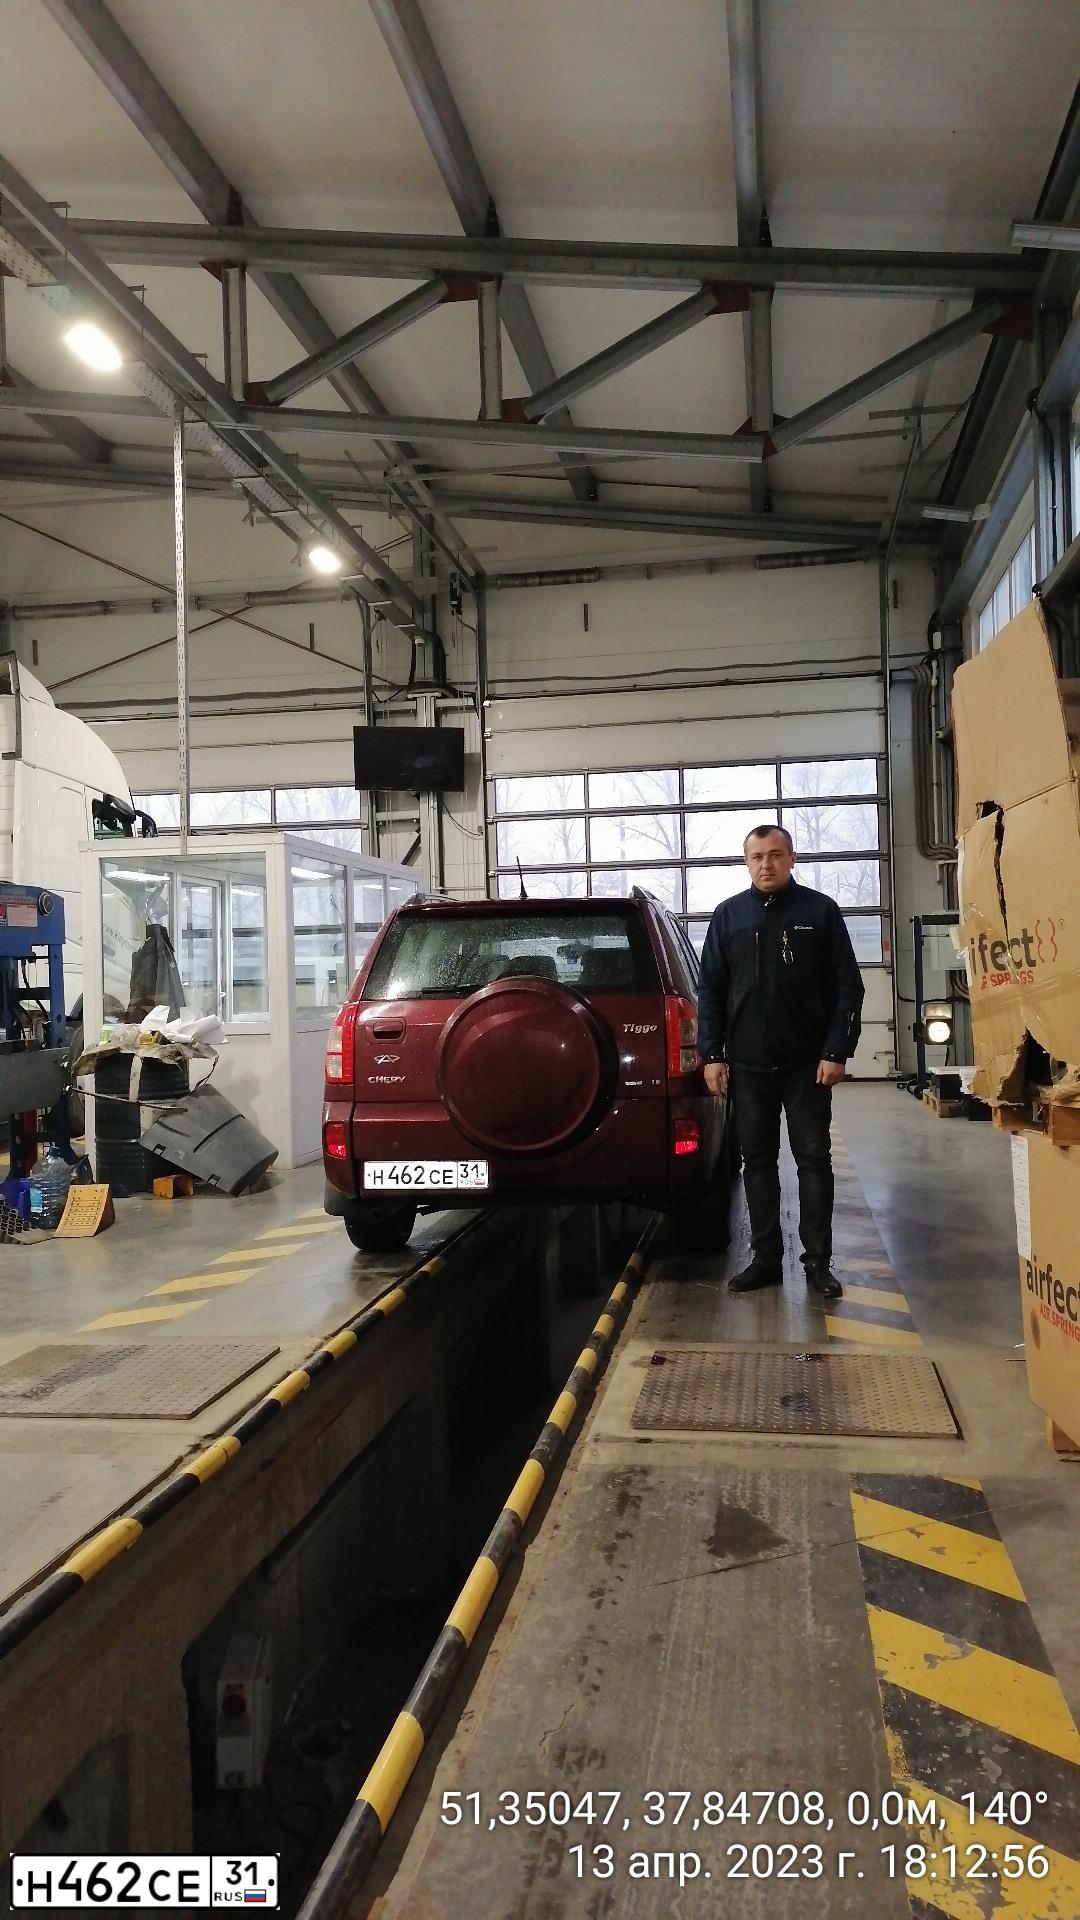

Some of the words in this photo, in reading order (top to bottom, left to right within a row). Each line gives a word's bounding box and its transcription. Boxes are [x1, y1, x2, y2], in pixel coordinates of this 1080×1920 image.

[623, 1023, 658, 1034] Tiggo
[367, 1075, 407, 1084] CHERY
[459, 1163, 479, 1179] 31
[1026, 1254, 1080, 1322] airfec
